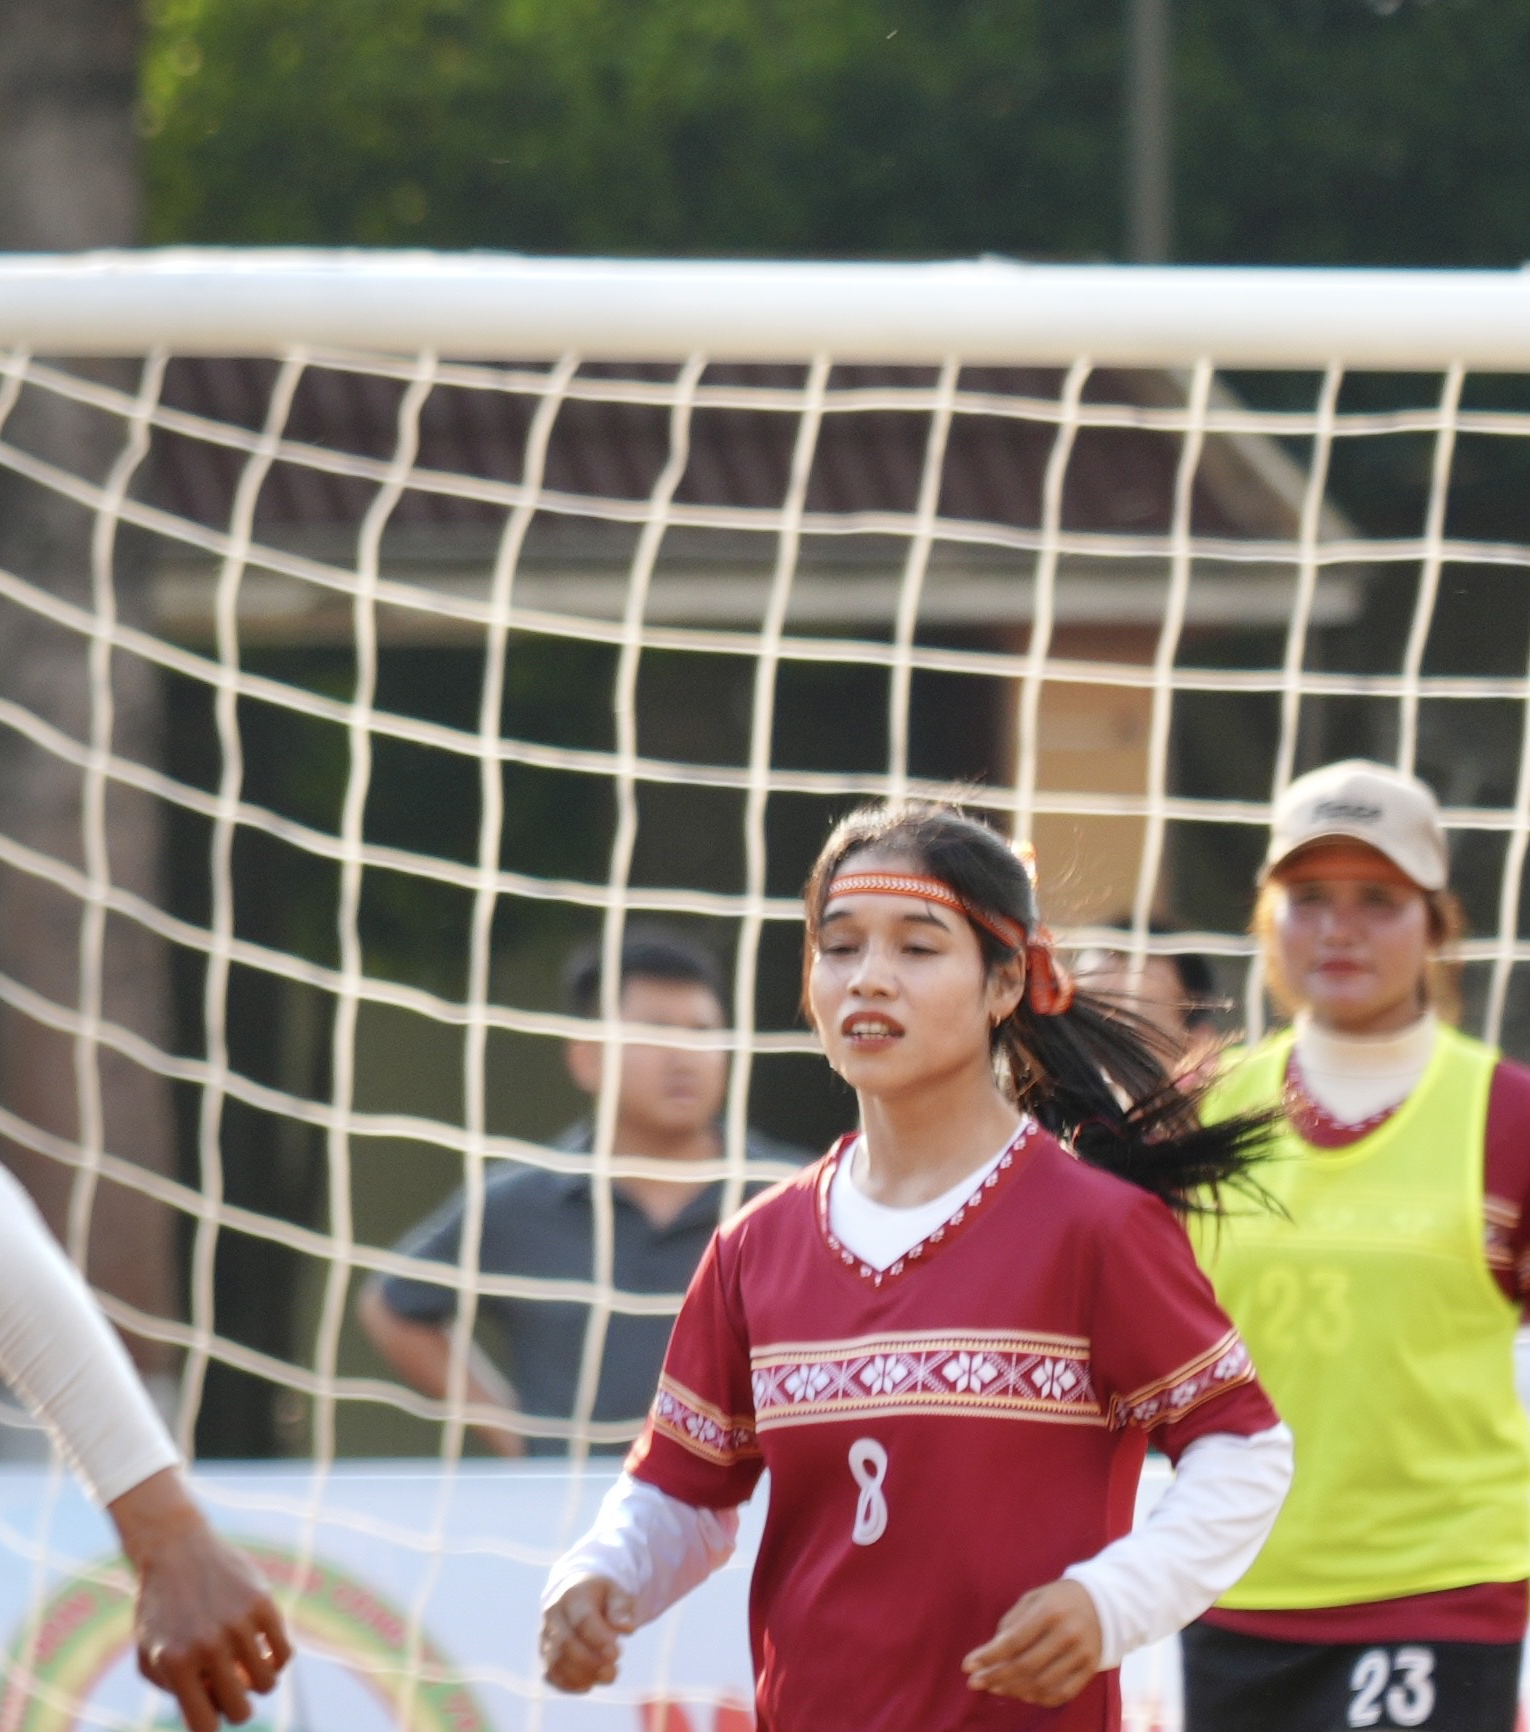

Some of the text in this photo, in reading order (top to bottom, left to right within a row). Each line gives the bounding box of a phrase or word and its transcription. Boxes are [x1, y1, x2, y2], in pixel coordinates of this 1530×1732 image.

[1256, 1267, 1352, 1352] 23
[848, 1438, 888, 1547] 8
[1347, 1646, 1436, 1727] 23
